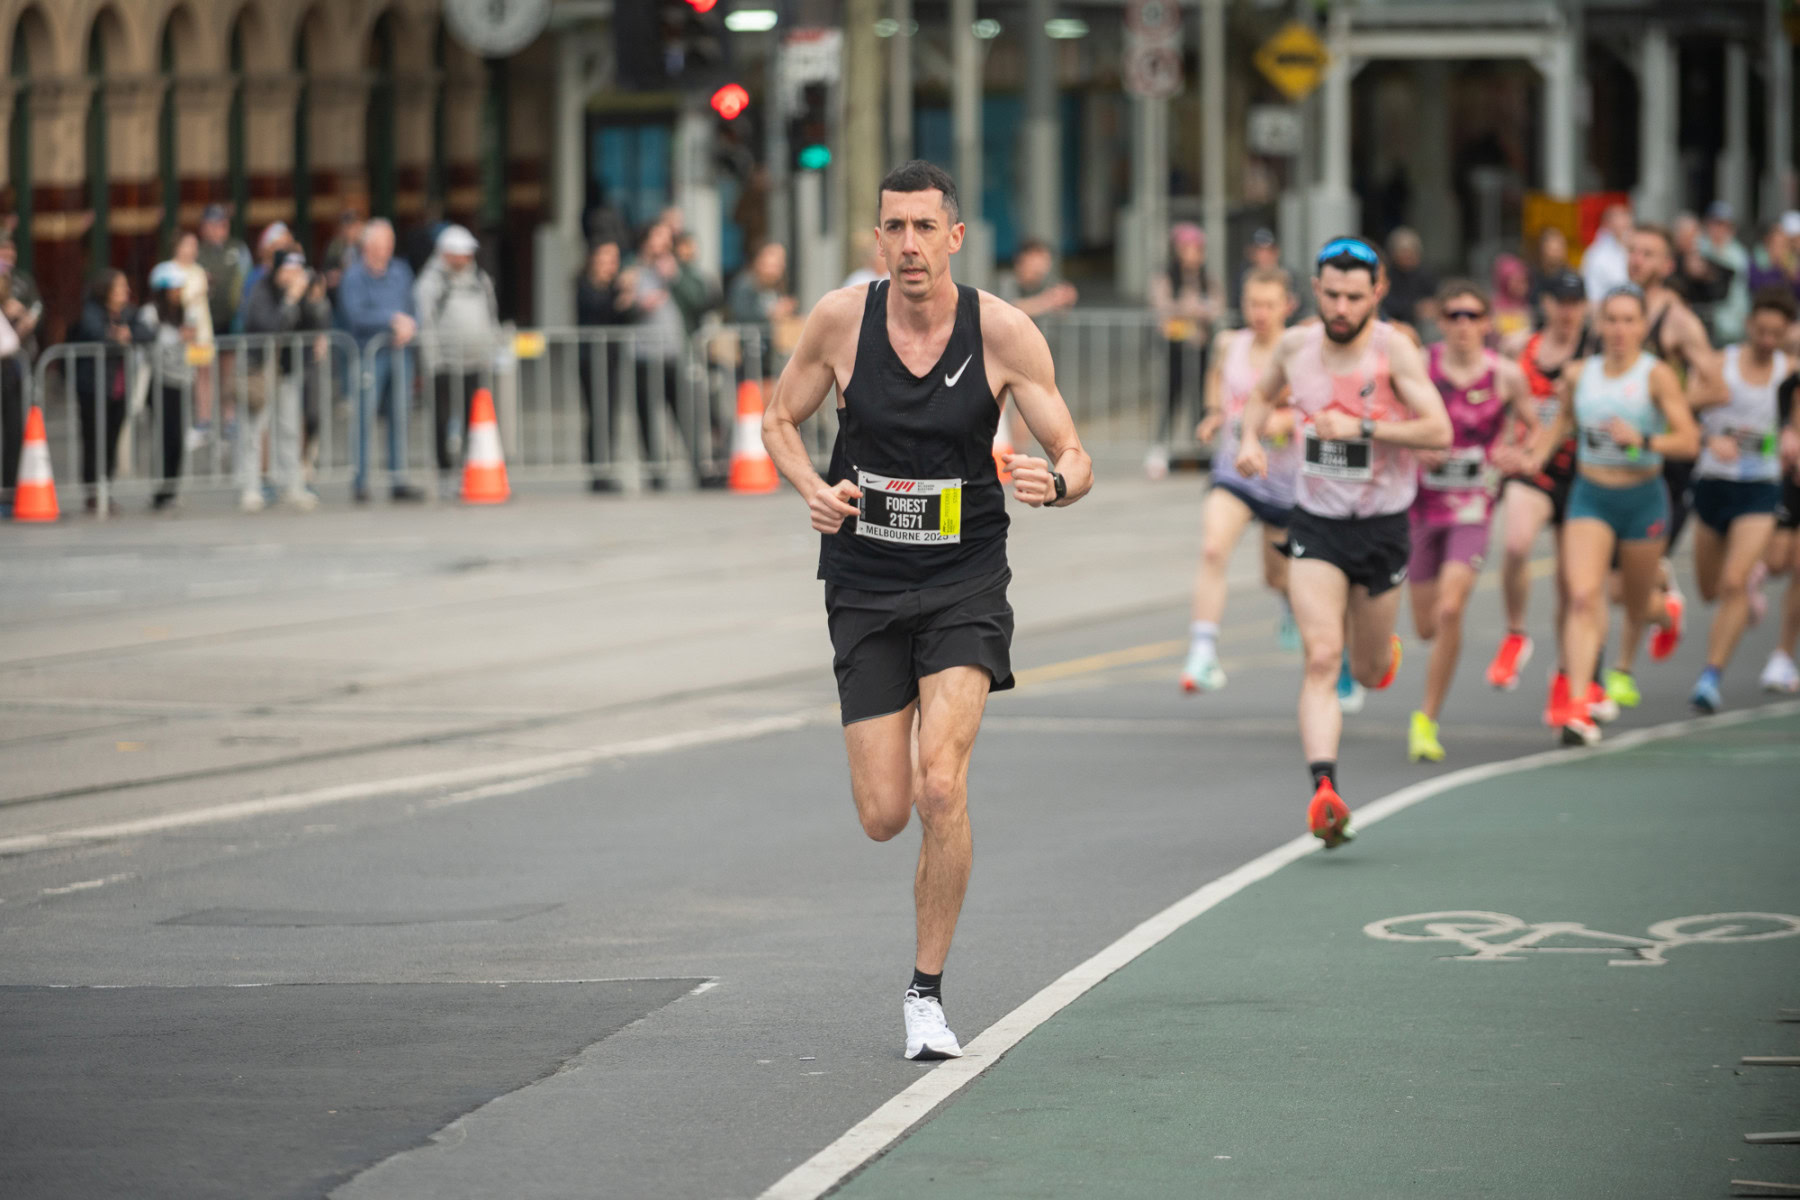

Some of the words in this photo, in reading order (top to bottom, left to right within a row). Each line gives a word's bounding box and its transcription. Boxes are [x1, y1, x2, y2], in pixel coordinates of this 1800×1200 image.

[886, 496, 927, 513] FOREST
[889, 512, 923, 529] 21571
[866, 525, 921, 541] MELBOURNE
